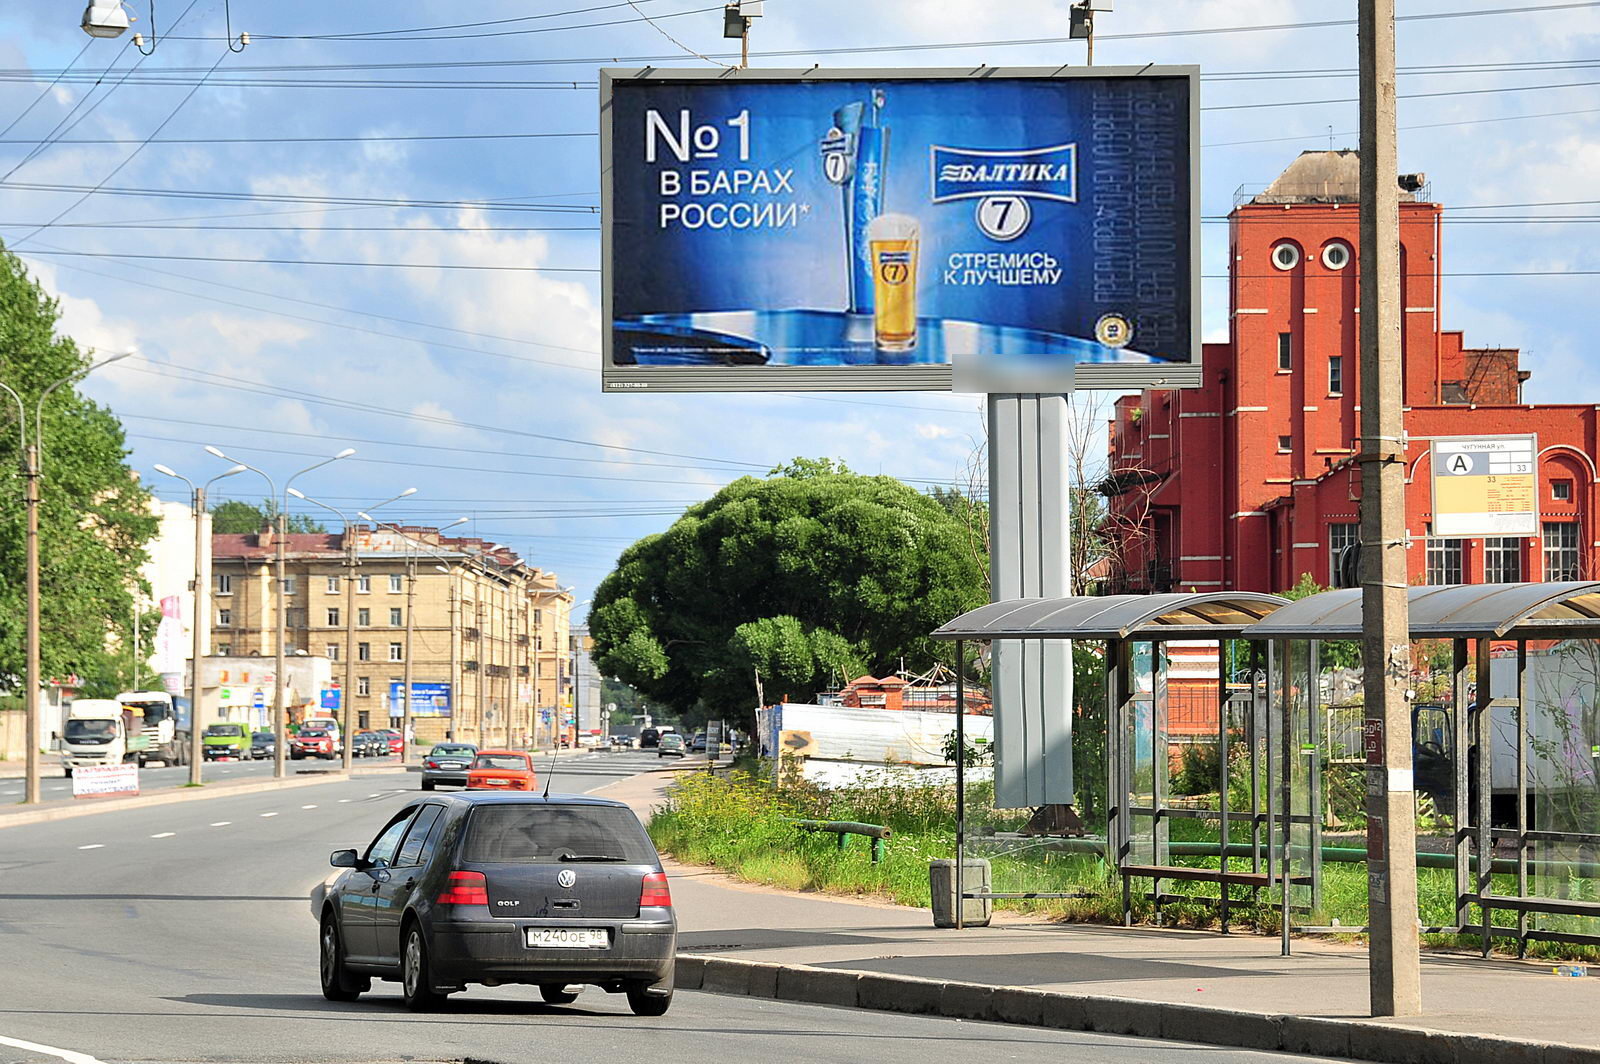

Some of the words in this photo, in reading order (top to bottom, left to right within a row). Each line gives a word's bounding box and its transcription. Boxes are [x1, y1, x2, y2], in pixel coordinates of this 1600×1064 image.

[1093, 89, 1132, 141] ВРЕДЕ
[660, 170, 681, 195] В
[691, 169, 793, 195] БАРАХ
[959, 164, 1068, 182] БАЛТИКА
[991, 201, 1013, 230] 7
[1093, 160, 1133, 303] ПРЕДУПРЕЖДАЕМ
[949, 253, 1057, 269] СТРЕМИСЬ
[944, 270, 961, 285] К
[963, 268, 1062, 285] ЛУЧШЕМУ
[1453, 455, 1467, 471] А
